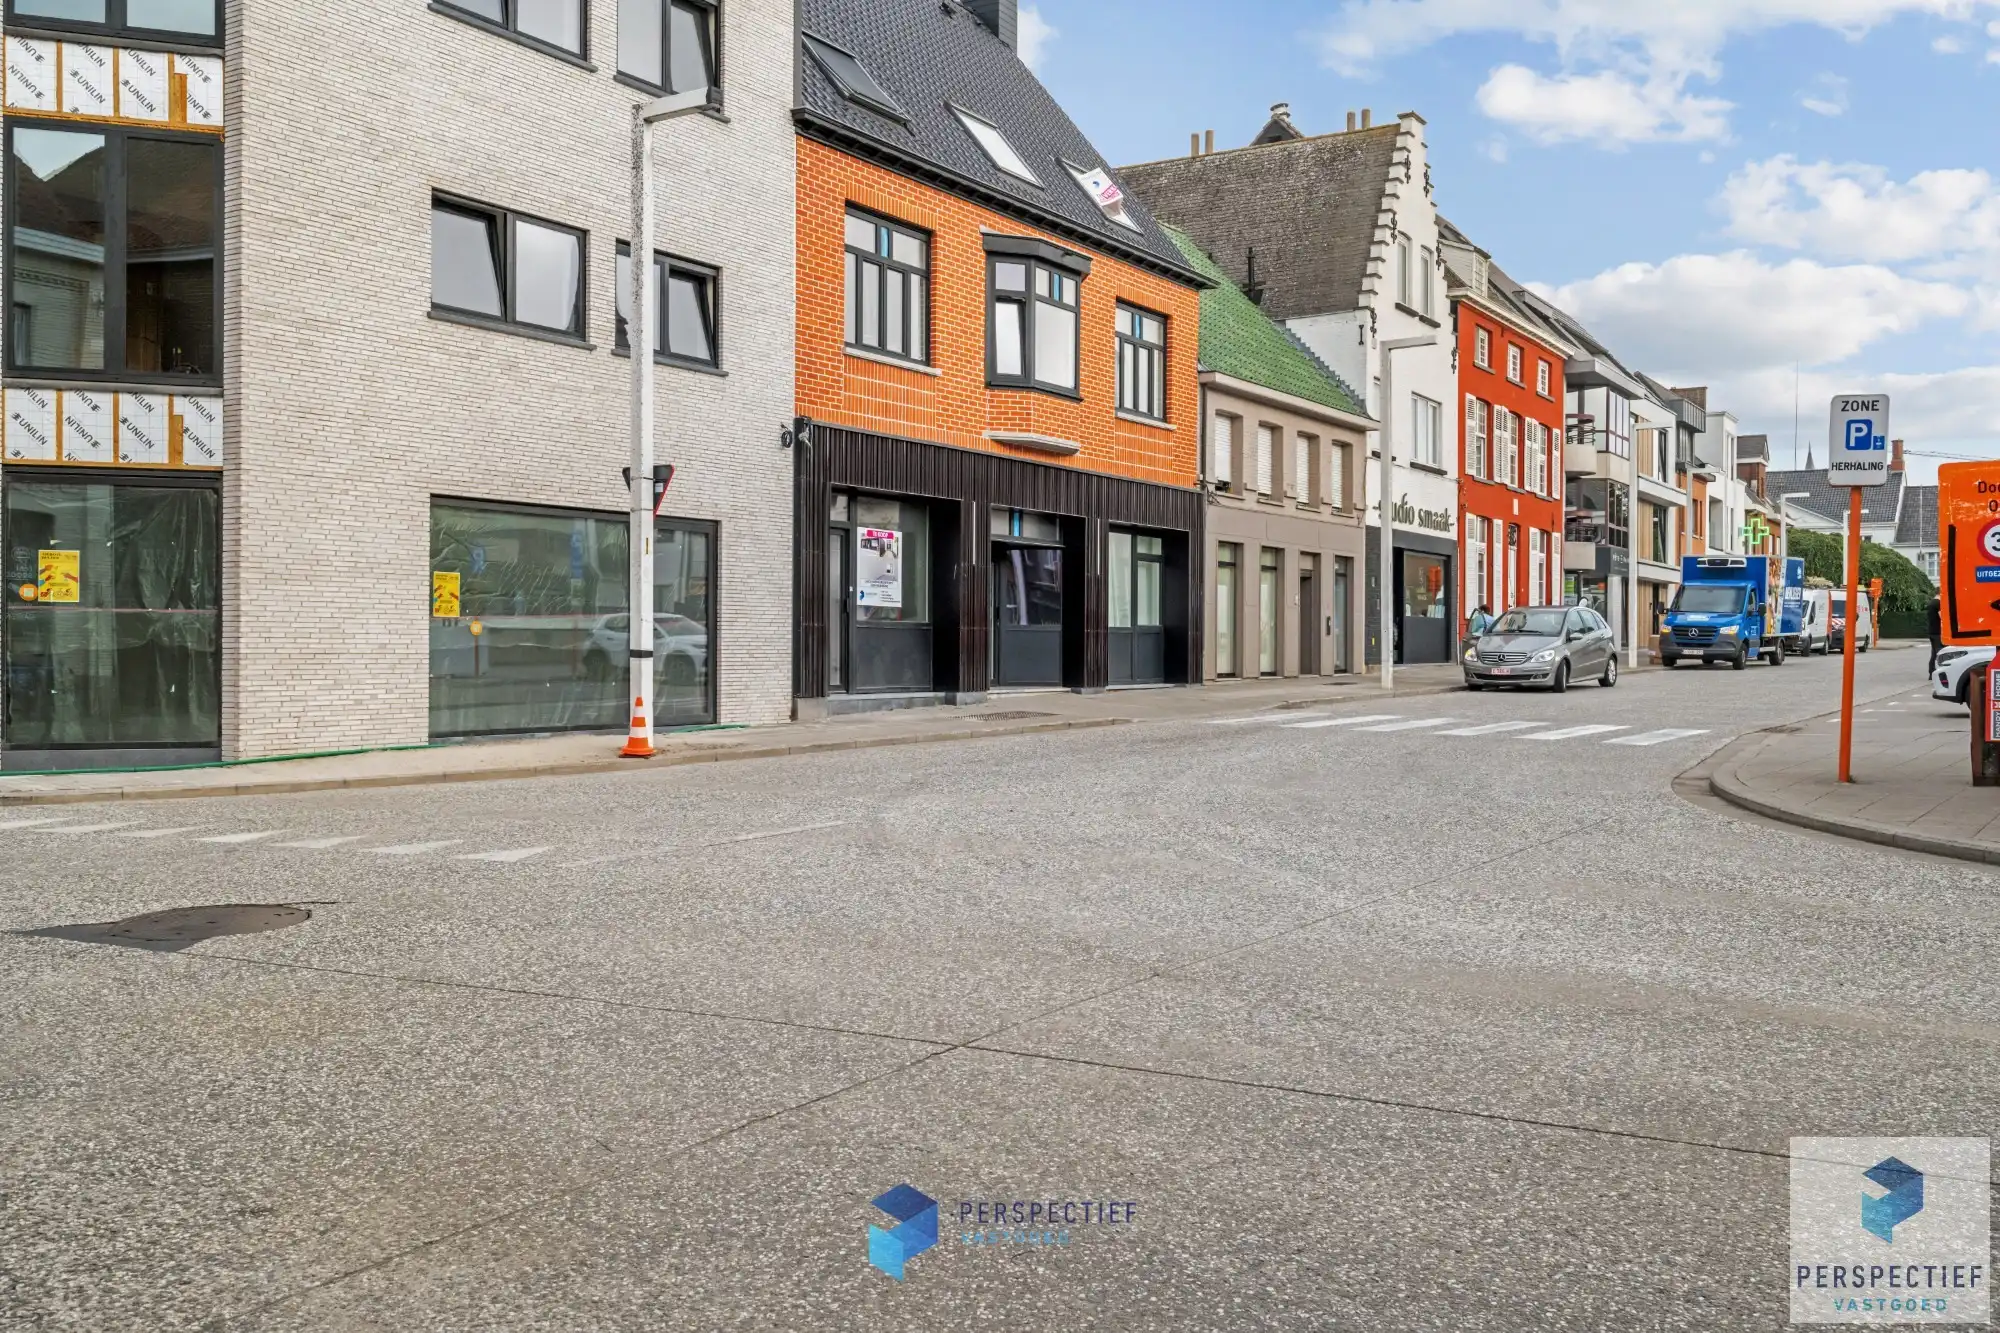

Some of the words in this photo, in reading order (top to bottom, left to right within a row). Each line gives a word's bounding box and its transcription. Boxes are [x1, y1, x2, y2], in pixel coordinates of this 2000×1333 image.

[128, 49, 156, 77] UNILIN
[8, 64, 37, 93] UNILIN
[77, 76, 106, 104] UNILIN
[128, 85, 156, 113] UNILIN
[186, 93, 204, 114] UNIL
[23, 387, 48, 409] NILIN
[188, 396, 216, 423] UNILIN
[1841, 400, 1880, 412] ZONE
[20, 419, 48, 446] UNILIN
[65, 416, 93, 443] UNILIN
[127, 422, 155, 450] UNILIN
[1849, 423, 1868, 447] P
[188, 432, 216, 459] UNILIN
[1831, 461, 1884, 471] HERHALING
